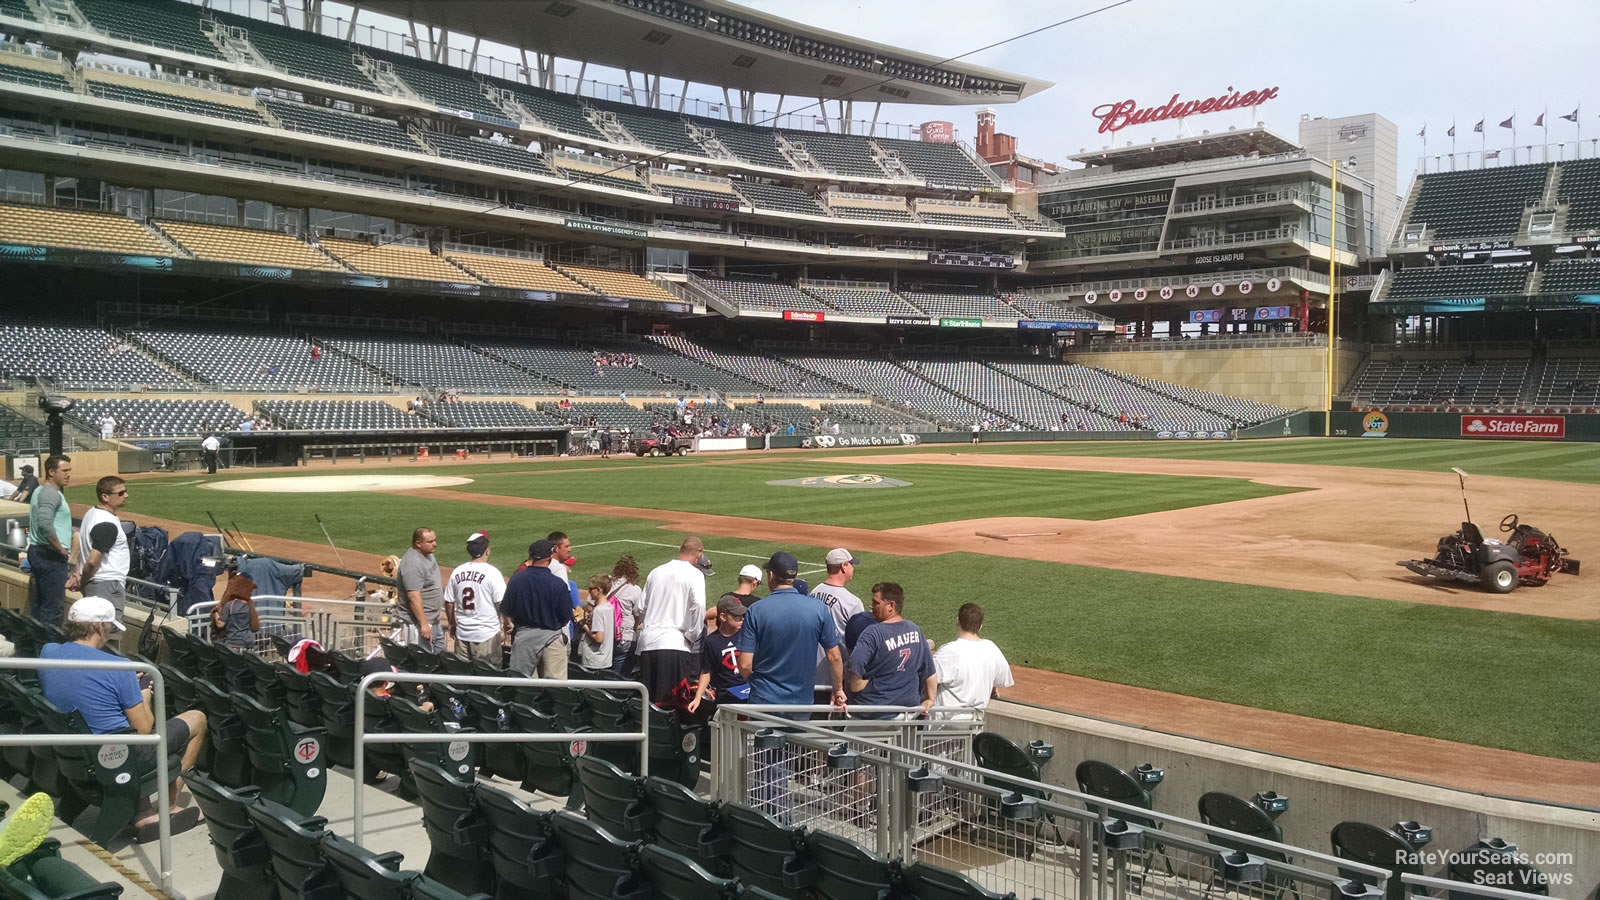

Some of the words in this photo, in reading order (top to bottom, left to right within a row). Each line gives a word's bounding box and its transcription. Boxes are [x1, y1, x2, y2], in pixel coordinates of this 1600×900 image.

[1092, 86, 1280, 134] Budweiser
[1067, 205, 1072, 214] A
[1073, 201, 1108, 213] BEAUTIFUL
[1110, 199, 1122, 208] DAY
[1136, 194, 1169, 205] BASEBALL
[573, 222, 592, 230] DELTA
[612, 227, 634, 235] LEGENDS
[1098, 232, 1121, 243] TWINS
[1195, 255, 1213, 264] GOOSE
[1212, 254, 1233, 263] ISLAND
[1233, 253, 1245, 261] PUB
[1162, 289, 1170, 297] 34
[1189, 287, 1196, 295] 14
[1488, 420, 1523, 432] State
[1523, 421, 1558, 433] Farm
[838, 436, 850, 446] Go
[851, 436, 871, 445] Music
[871, 436, 882, 445] Go
[882, 435, 900, 445] Twins
[454, 570, 486, 585] DOZIER
[462, 586, 476, 611] 2
[885, 631, 920, 651] MAUER
[897, 648, 911, 672] 7
